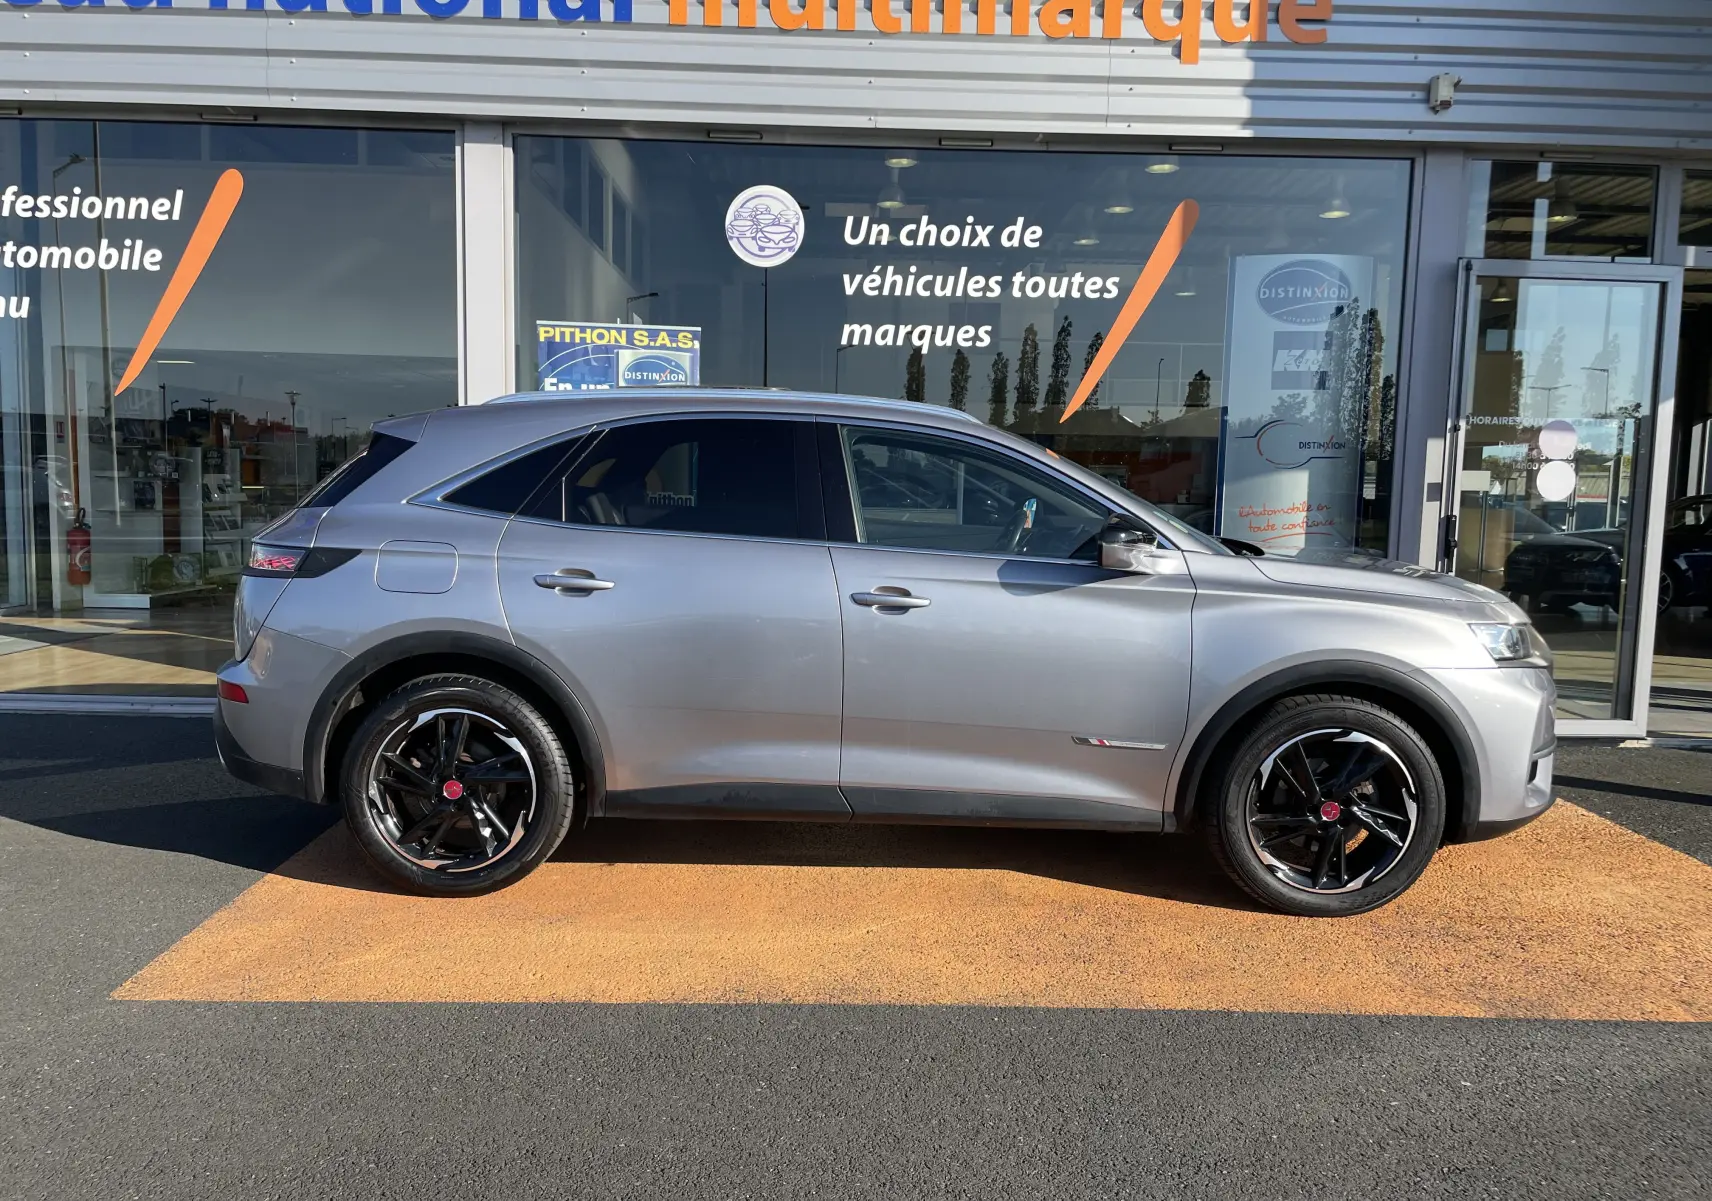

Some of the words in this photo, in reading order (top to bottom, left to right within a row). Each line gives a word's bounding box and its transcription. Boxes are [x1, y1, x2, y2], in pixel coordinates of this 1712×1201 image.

[1, 185, 184, 221] fessionnel
[843, 215, 890, 246] Un
[899, 215, 994, 248] choix
[1000, 216, 1043, 248] de
[0, 238, 163, 271] tomobile
[842, 265, 1002, 299] véhicules
[1011, 271, 1120, 299] toutes
[1260, 283, 1349, 299] DISTINXION
[0, 296, 30, 318] u
[539, 326, 627, 345] PITHON
[840, 321, 992, 355] marques
[625, 370, 686, 382] DISTINXION
[1299, 437, 1346, 452] DISTINXION
[1248, 519, 1278, 533] toute
[1281, 515, 1336, 532] confiance
